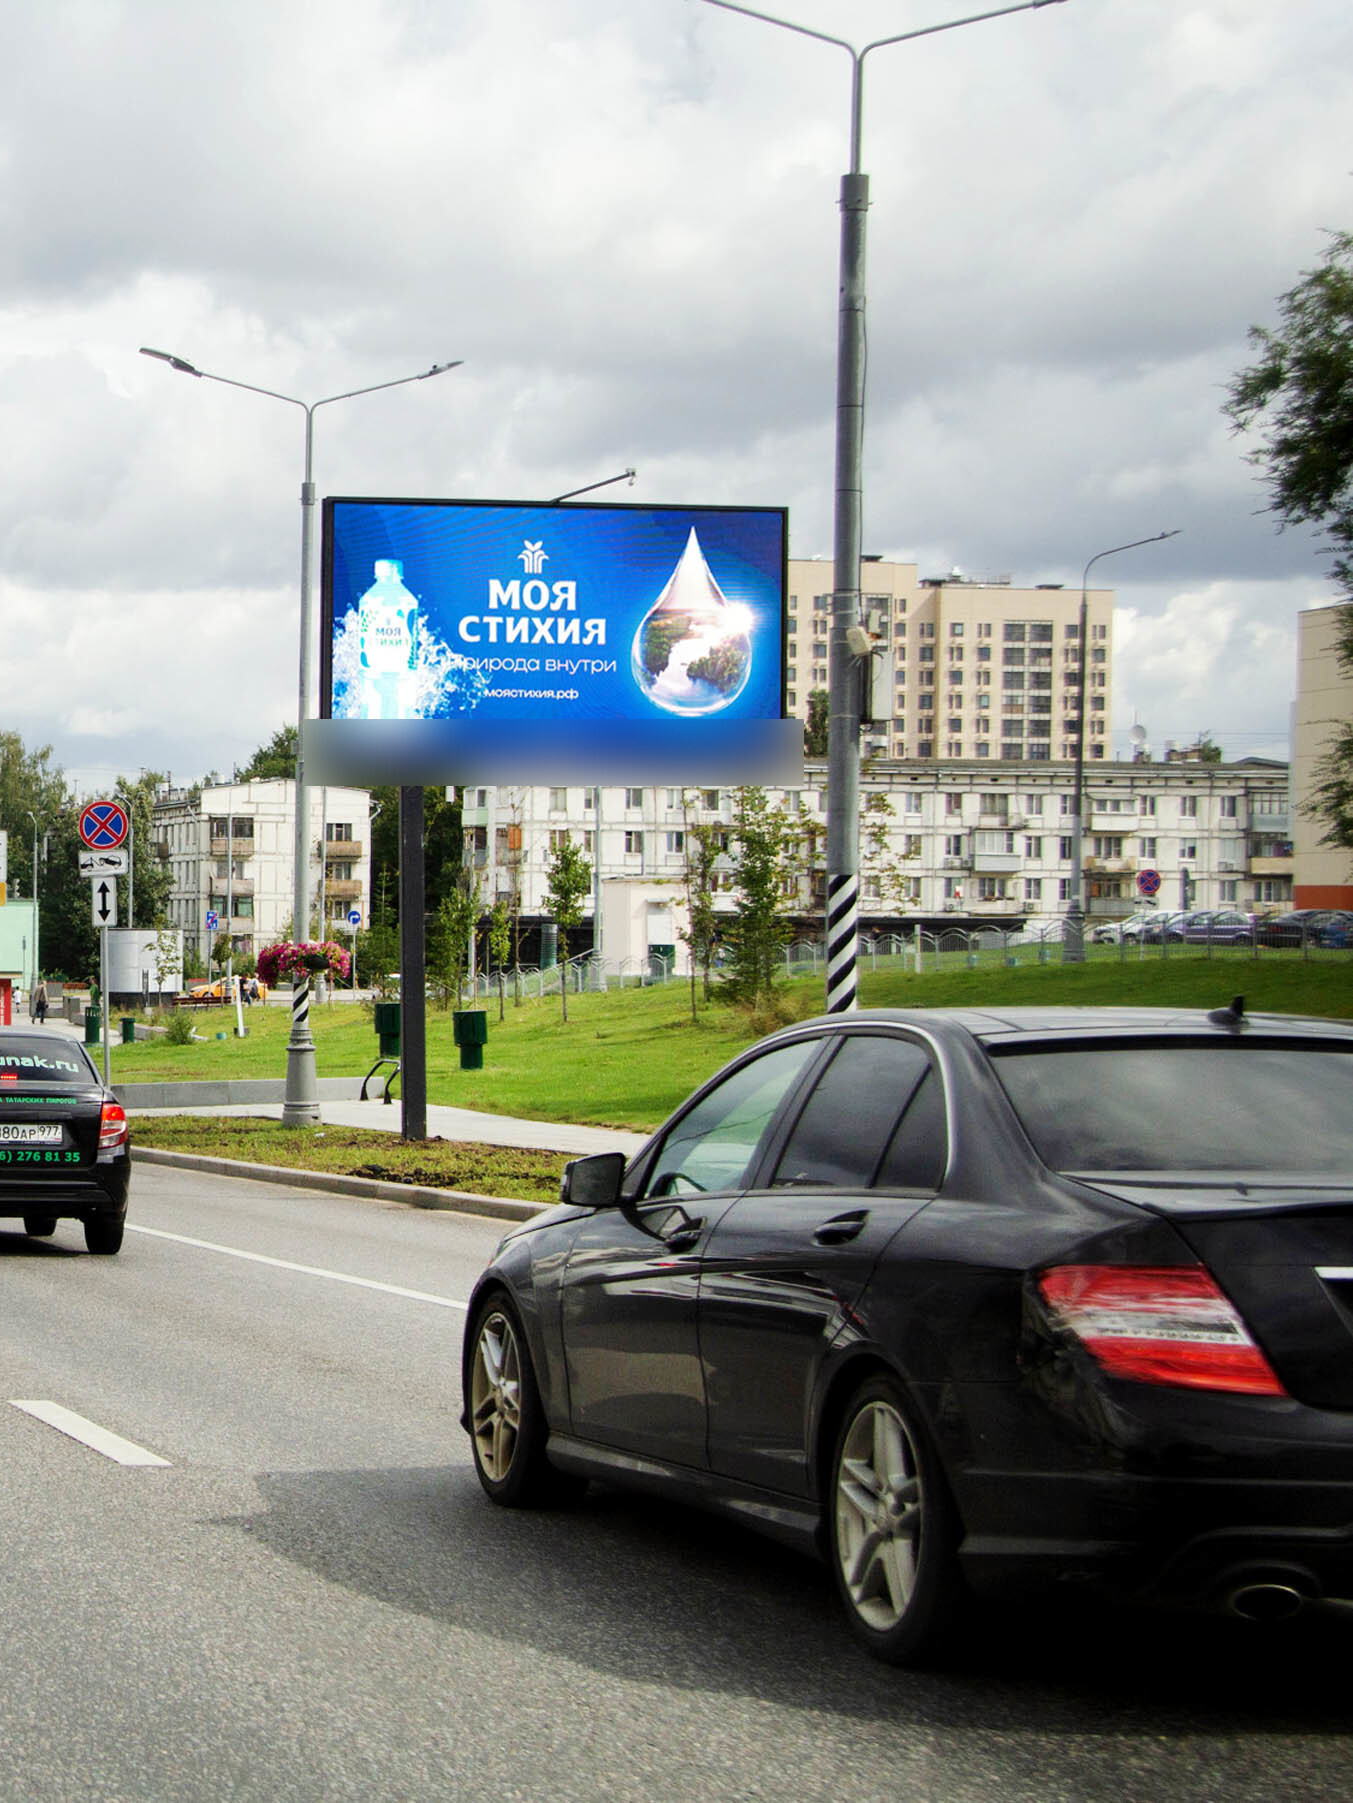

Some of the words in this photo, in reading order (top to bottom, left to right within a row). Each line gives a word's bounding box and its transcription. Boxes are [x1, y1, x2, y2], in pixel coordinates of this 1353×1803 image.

[488, 579, 576, 611] МОЯ
[376, 627, 400, 636] МОЯ
[458, 616, 606, 645] СТИХИЯ
[455, 656, 540, 673] рирода
[544, 658, 617, 675] внутри
[485, 688, 579, 700] моястихия.рф
[39, 1126, 59, 1136] 977
[17, 1151, 41, 1161] 276
[45, 1152, 60, 1162] 81
[65, 1152, 80, 1162] 35
